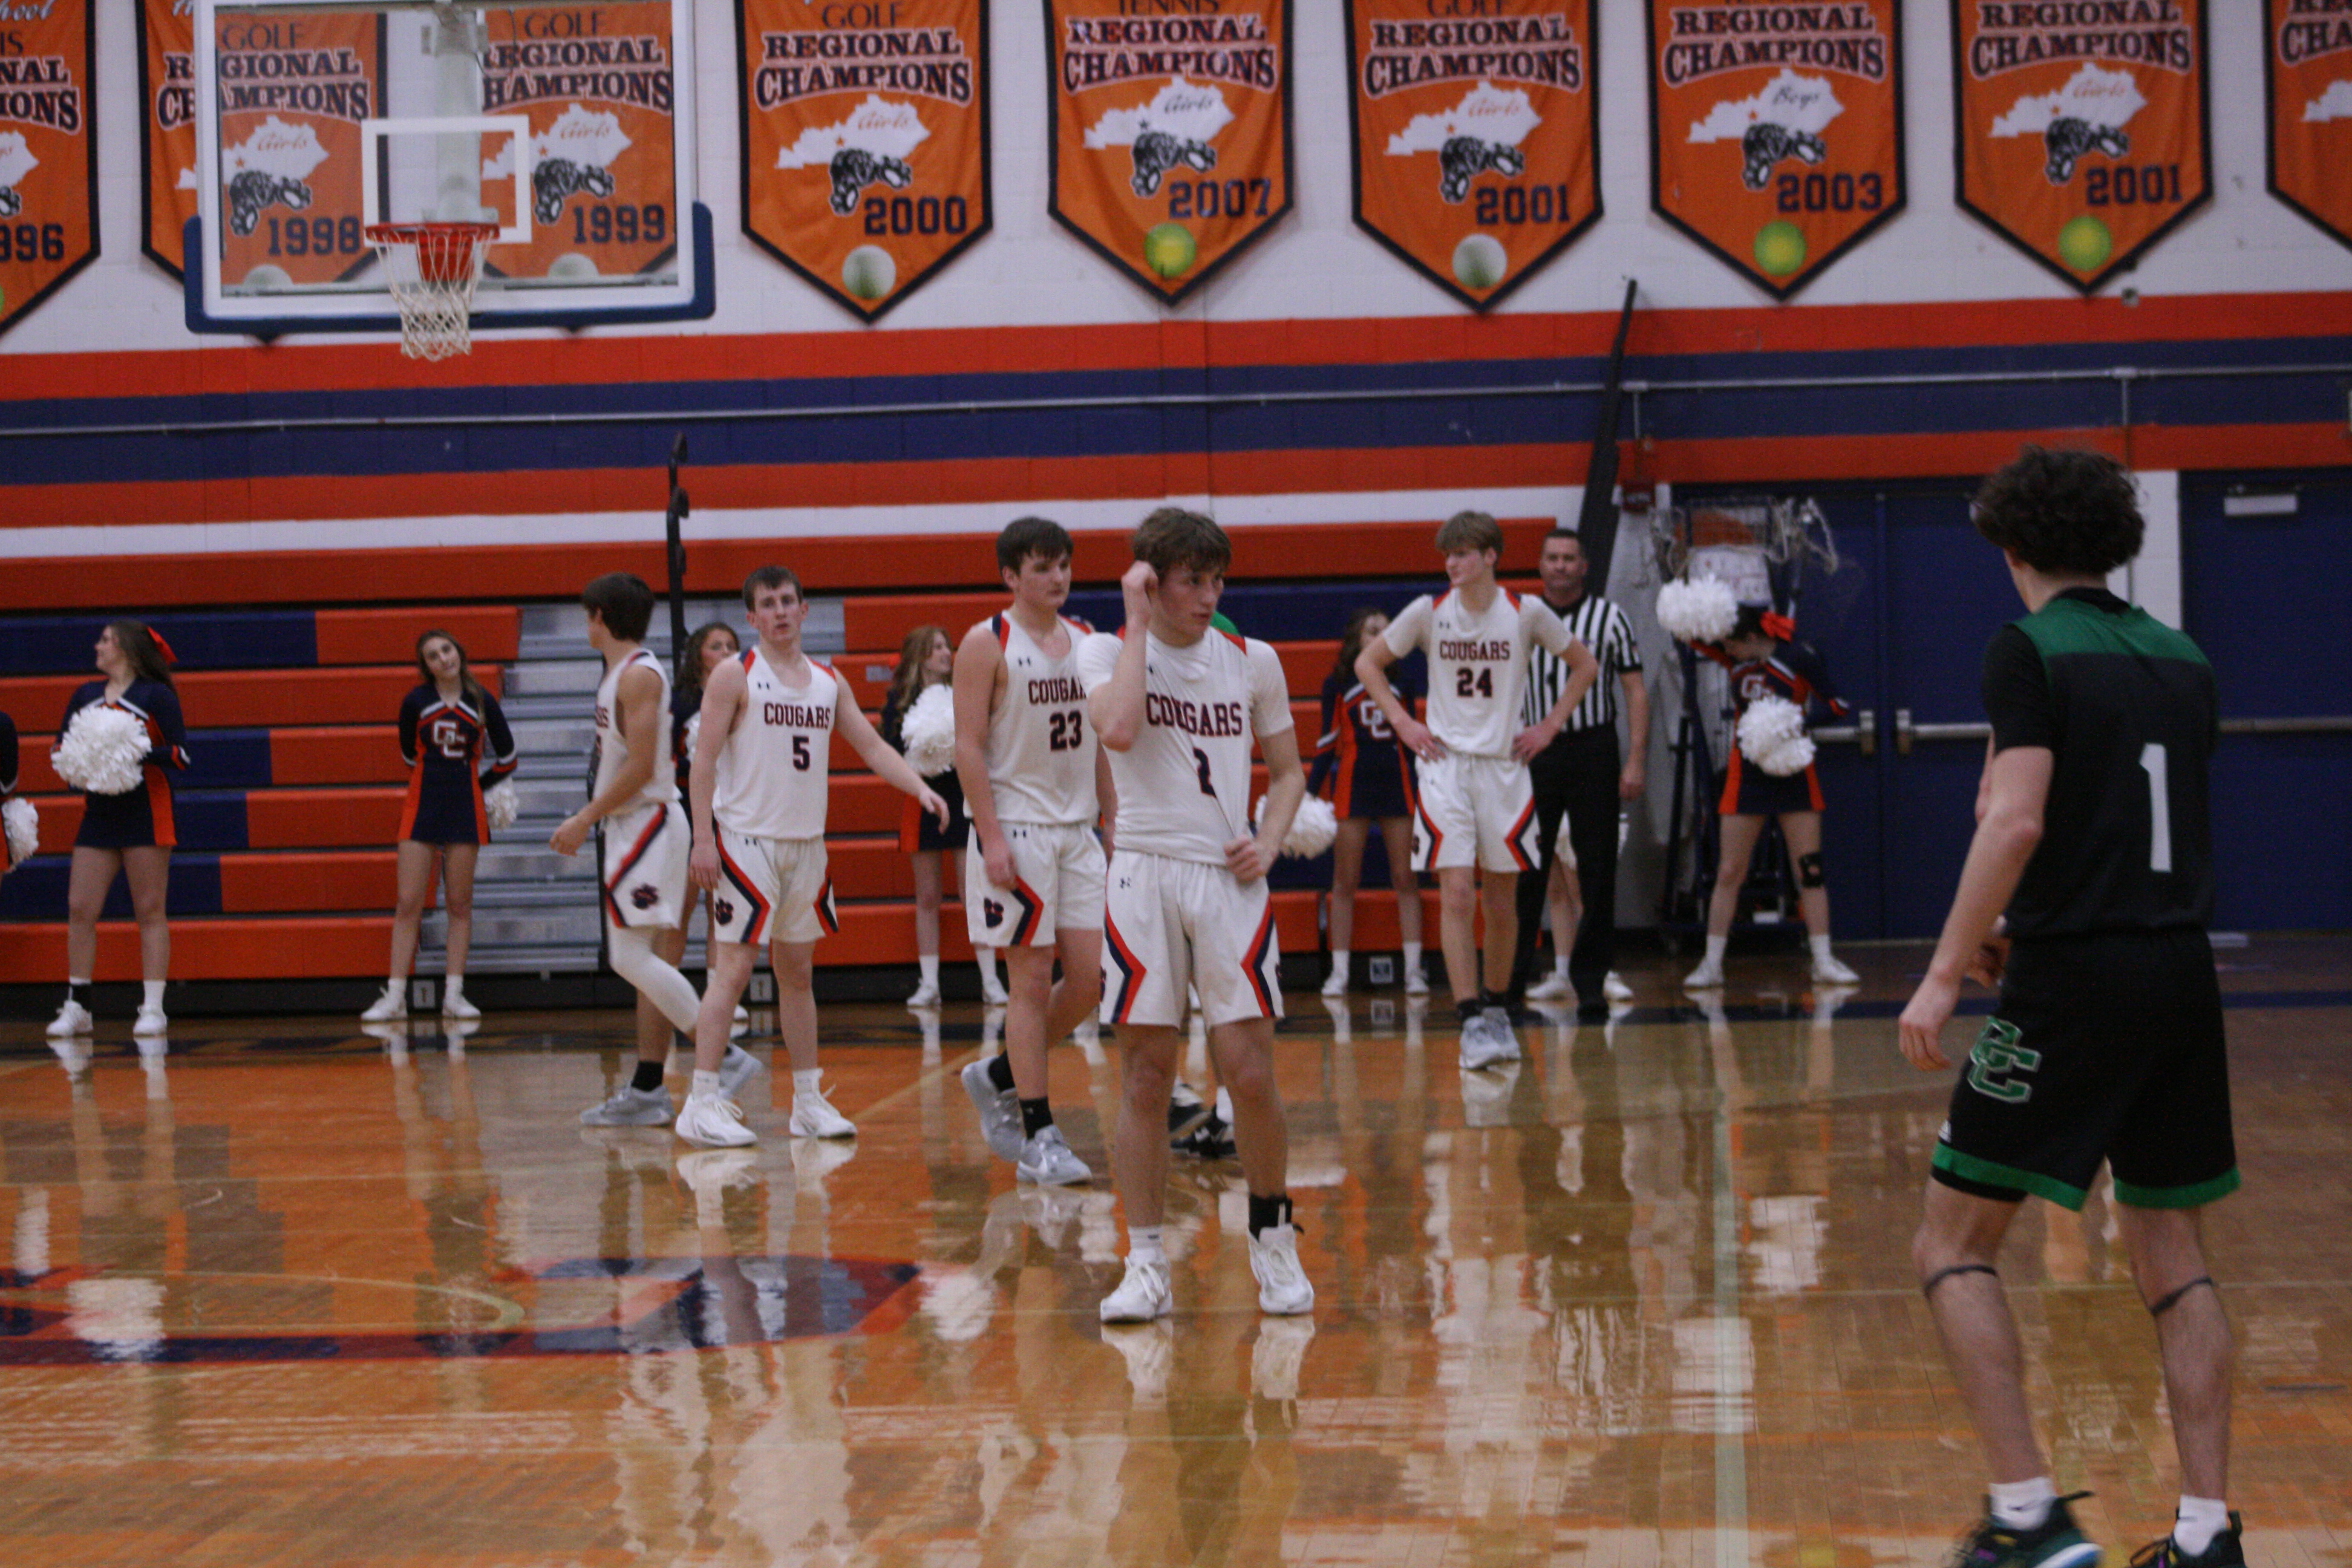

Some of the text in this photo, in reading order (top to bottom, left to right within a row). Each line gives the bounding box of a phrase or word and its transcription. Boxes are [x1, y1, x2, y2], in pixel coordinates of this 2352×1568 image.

[524, 10, 605, 38] GOLF
[822, 2, 906, 29] GOLF
[1068, 17, 1266, 44] REGIONAL
[1373, 17, 1570, 47] REGIONAL
[1673, 6, 1873, 34] REGIONAL
[1982, 0, 2180, 26] REGIONAL
[221, 22, 305, 50] GOLF
[764, 30, 961, 59] REGIONAL
[1971, 29, 2191, 76] CHAMPIONS
[1063, 47, 1275, 91] CHAMPIONS
[1365, 47, 1581, 95] CHAMPIONS
[1664, 37, 1884, 83] CHAMPIONS
[484, 70, 673, 110] HAMPIONS
[756, 60, 970, 108] CHAMPIONS
[1168, 178, 1270, 218] 2007
[1475, 185, 1570, 225] 2001
[1777, 172, 1883, 214] 2003
[2086, 164, 2183, 206] 2001
[267, 216, 360, 256] 1998
[572, 204, 665, 243] 1999
[863, 195, 967, 237] 2000
[1439, 640, 1511, 661] COUGARS
[1028, 675, 1087, 705] COUGA
[1456, 667, 1493, 698] 24
[763, 702, 831, 730] COUGARS
[1049, 710, 1082, 751] 23
[1146, 692, 1243, 737] COUGARS
[792, 734, 810, 772] 5
[2138, 742, 2172, 873] 1
